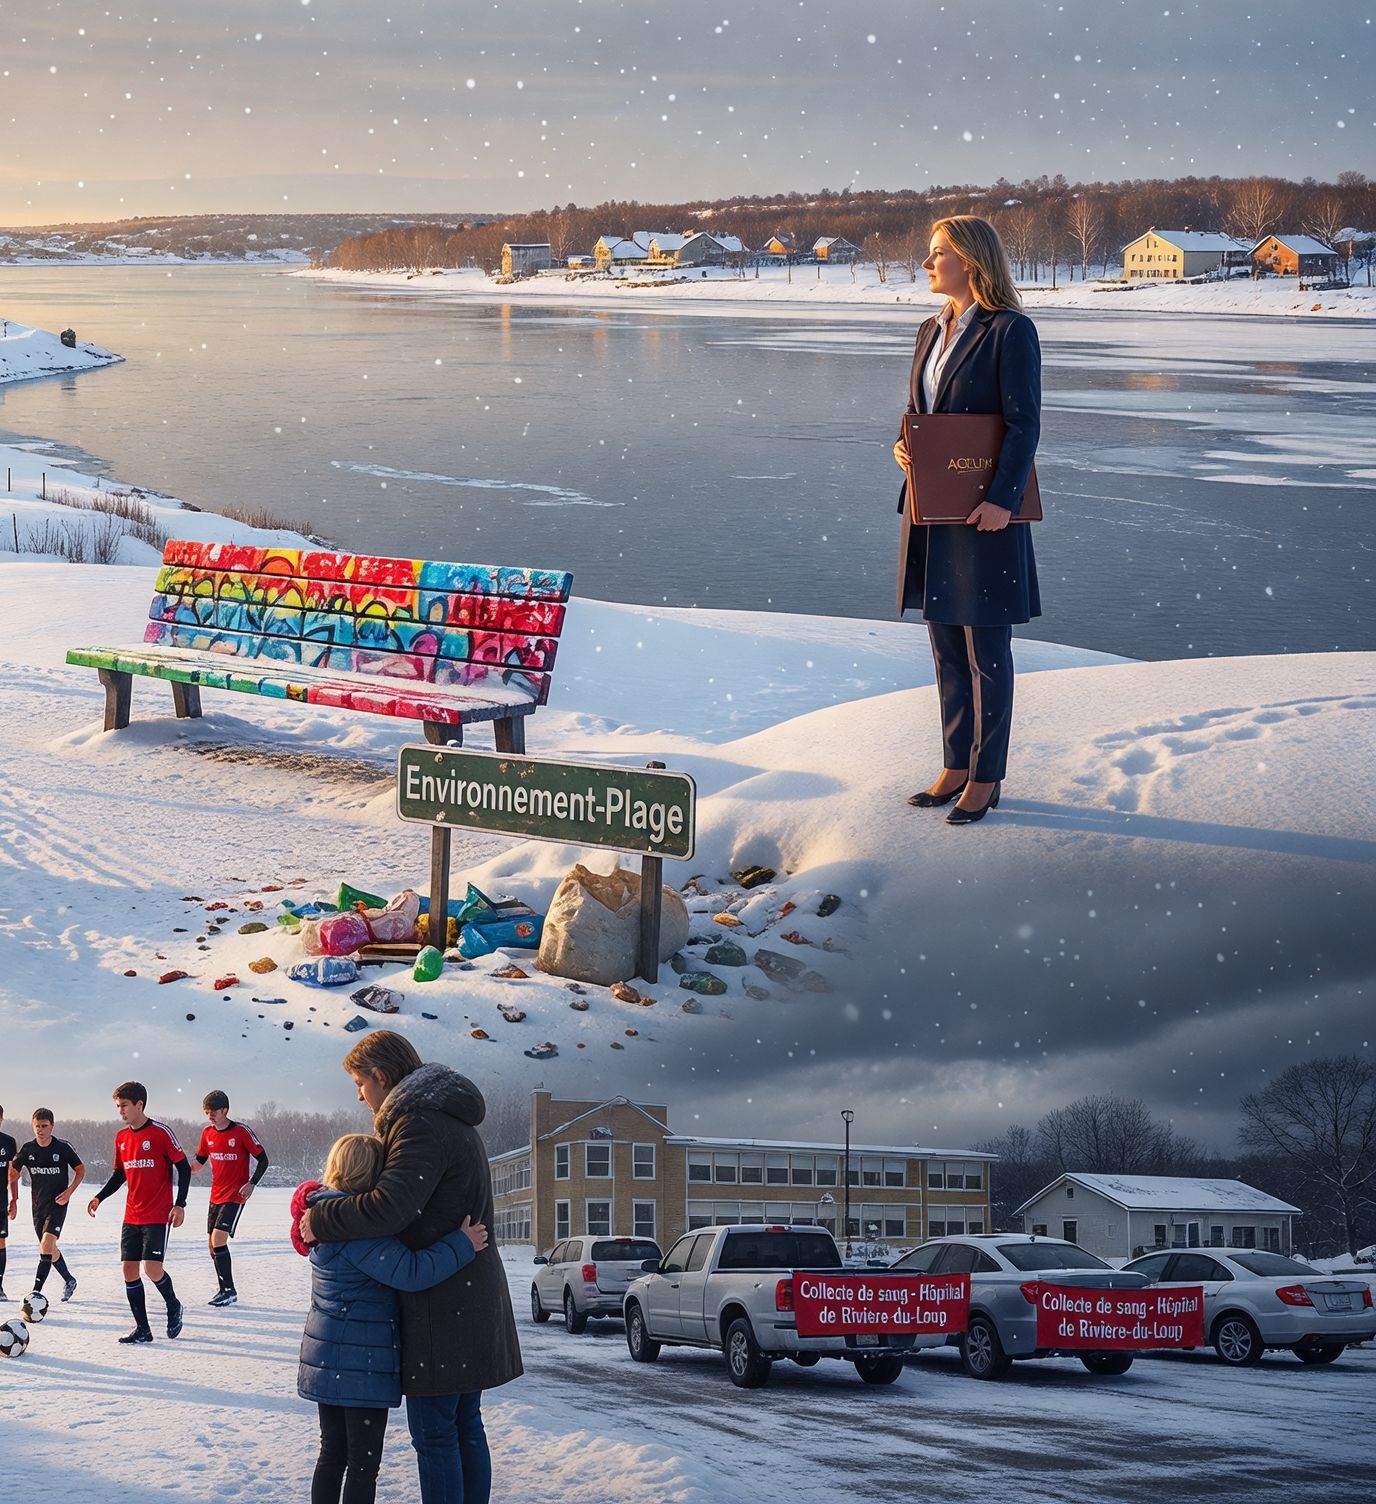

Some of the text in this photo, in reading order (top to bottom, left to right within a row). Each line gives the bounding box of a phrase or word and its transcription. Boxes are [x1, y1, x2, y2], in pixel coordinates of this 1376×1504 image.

[405, 764, 684, 844] Environnement-Plage
[800, 1280, 854, 1301] Collecte
[858, 1285, 874, 1301] de
[878, 1288, 908, 1305] sang
[1042, 1291, 1092, 1313] Collecte
[1096, 1297, 1112, 1314] de
[1116, 1301, 1146, 1319] sang
[819, 1306, 836, 1324] de
[1058, 1317, 1074, 1337] de
